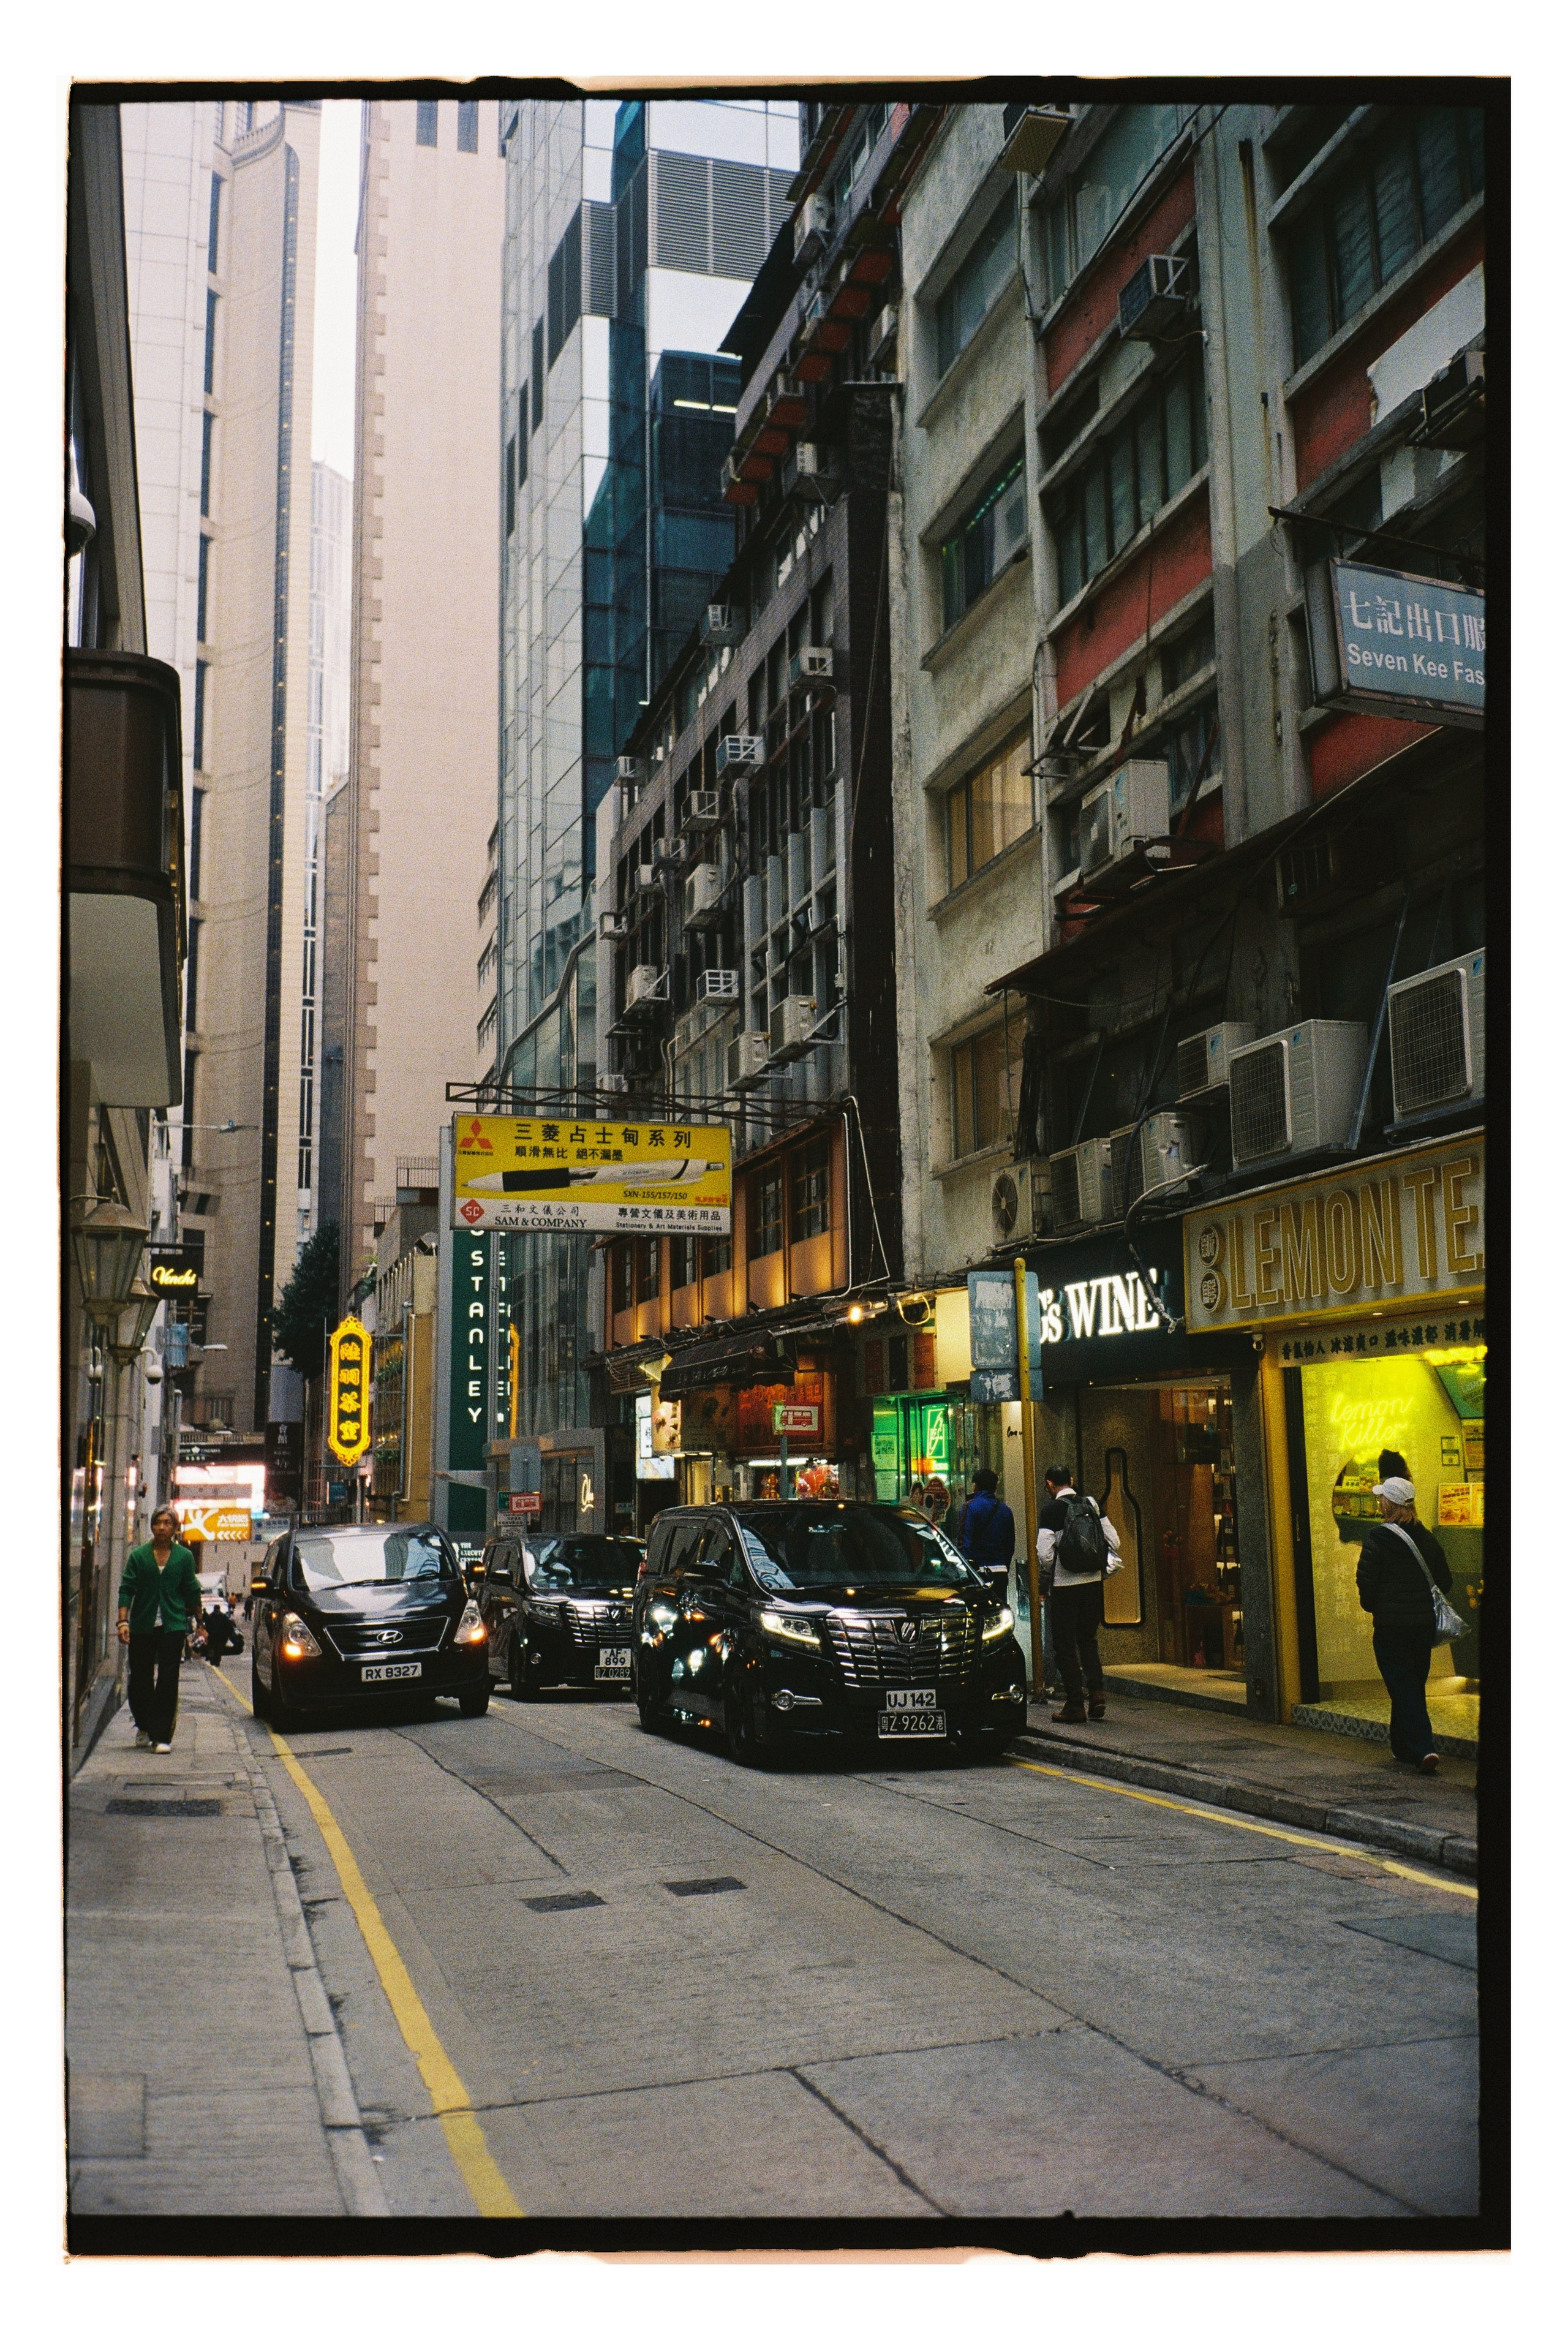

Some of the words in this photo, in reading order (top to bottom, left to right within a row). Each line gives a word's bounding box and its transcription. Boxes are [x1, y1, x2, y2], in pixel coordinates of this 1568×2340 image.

[1348, 643, 1408, 672] Seven
[1413, 653, 1448, 679] Kee
[514, 1123, 692, 1148] 三菱占士甸系列
[514, 1145, 568, 1159] 順滑無比
[623, 1190, 688, 1200] SXN-155/157/150
[500, 1204, 579, 1217] 三和文儀公司
[617, 1207, 721, 1221] 專營文儀及美術用品
[495, 1217, 518, 1226] SAM
[521, 1218, 529, 1226] &
[532, 1218, 587, 1228] COMPANY
[1227, 1179, 1398, 1310] LEMON
[153, 1266, 197, 1285] Venchi
[1065, 1267, 1160, 1338] WINE
[1338, 1416, 1408, 1450] Killer
[609, 1648, 622, 1658] AF
[605, 1657, 625, 1666] 899
[366, 1669, 381, 1679] RX
[385, 1666, 418, 1677] 8327
[888, 1694, 907, 1707] UJ
[910, 1692, 935, 1707] 142
